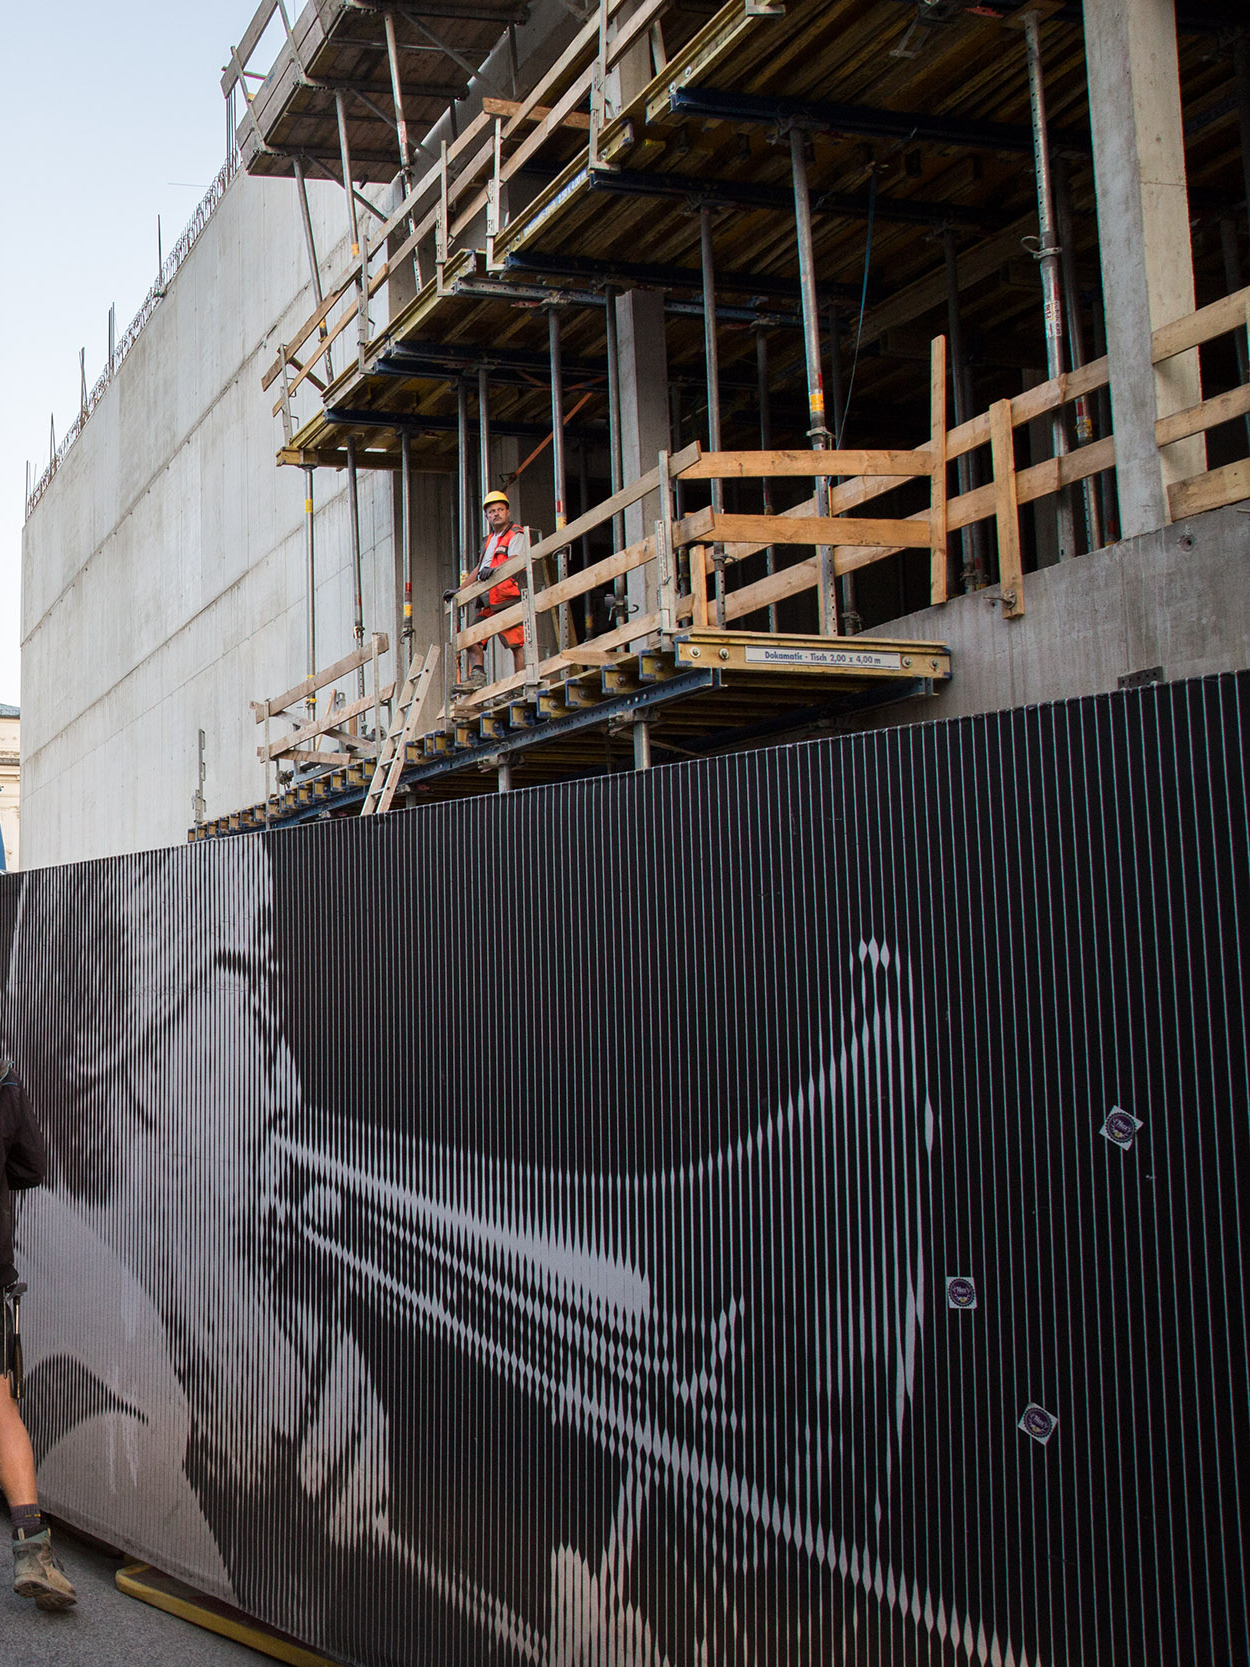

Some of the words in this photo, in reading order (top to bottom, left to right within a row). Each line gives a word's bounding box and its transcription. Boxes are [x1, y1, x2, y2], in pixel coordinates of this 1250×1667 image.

[764, 650, 803, 661] Dokamatic
[810, 652, 827, 662] Tisch
[829, 653, 846, 664] 2,00
[855, 655, 873, 665] 4,00
